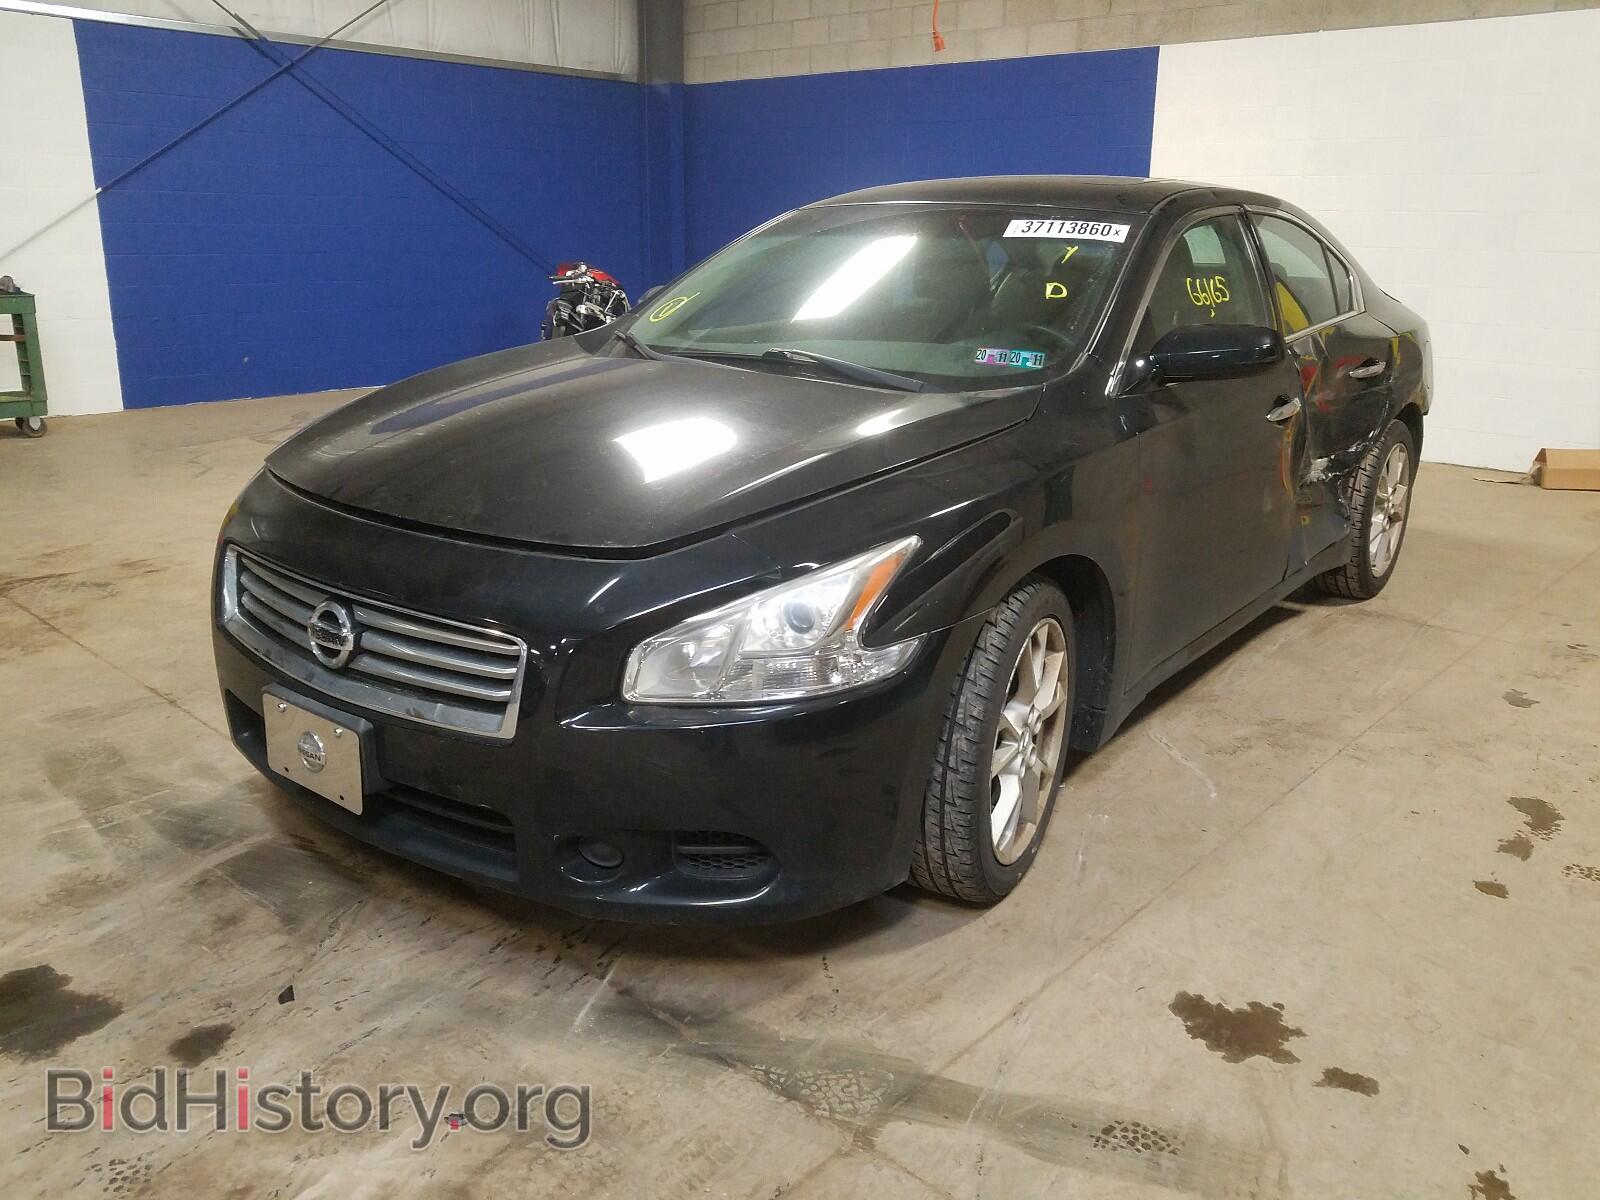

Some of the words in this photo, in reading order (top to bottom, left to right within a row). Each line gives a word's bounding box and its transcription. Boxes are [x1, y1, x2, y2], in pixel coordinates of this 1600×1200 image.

[1045, 282, 1068, 299] D
[975, 349, 987, 360] 20
[1009, 351, 1021, 364] 20
